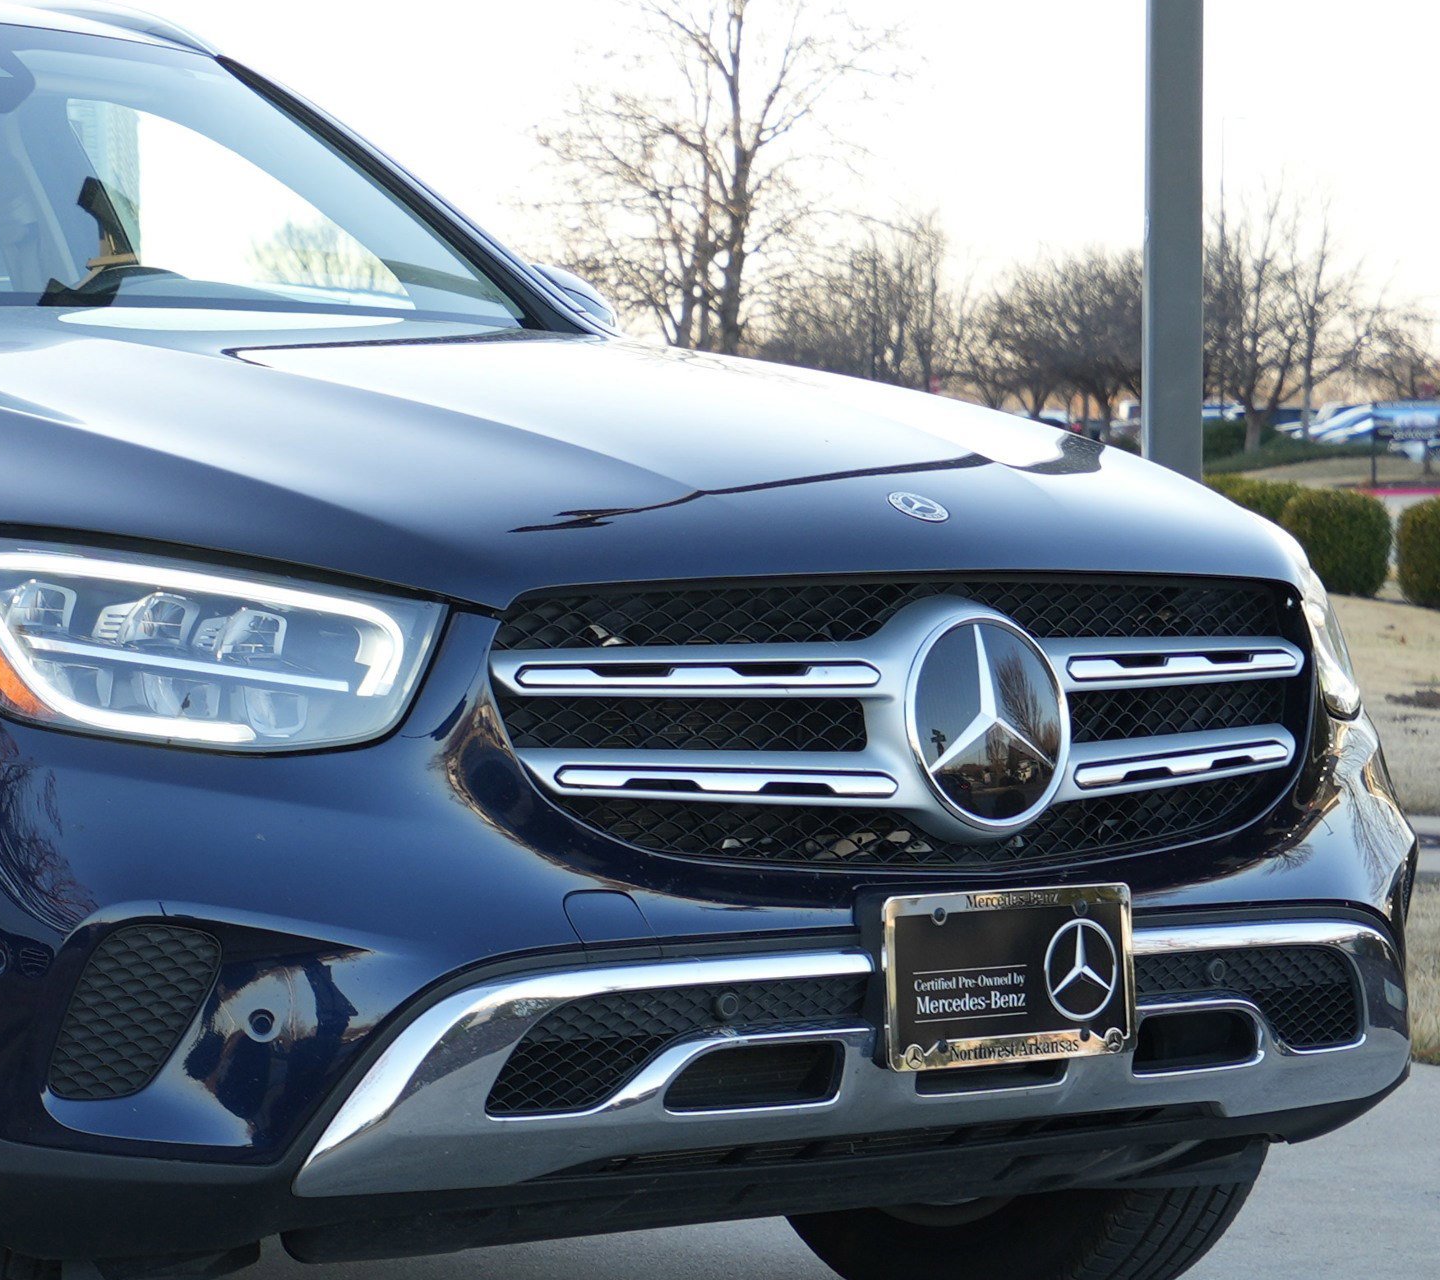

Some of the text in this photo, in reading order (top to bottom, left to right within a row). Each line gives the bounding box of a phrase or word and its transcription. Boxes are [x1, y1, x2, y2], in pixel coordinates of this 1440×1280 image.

[966, 892, 1058, 909] Mercedes-Benz
[914, 972, 1025, 992] Certified Pre-Owned by
[916, 991, 1026, 1015] Mercedes-Benz
[950, 1039, 1079, 1062] Northwest Arkansas
